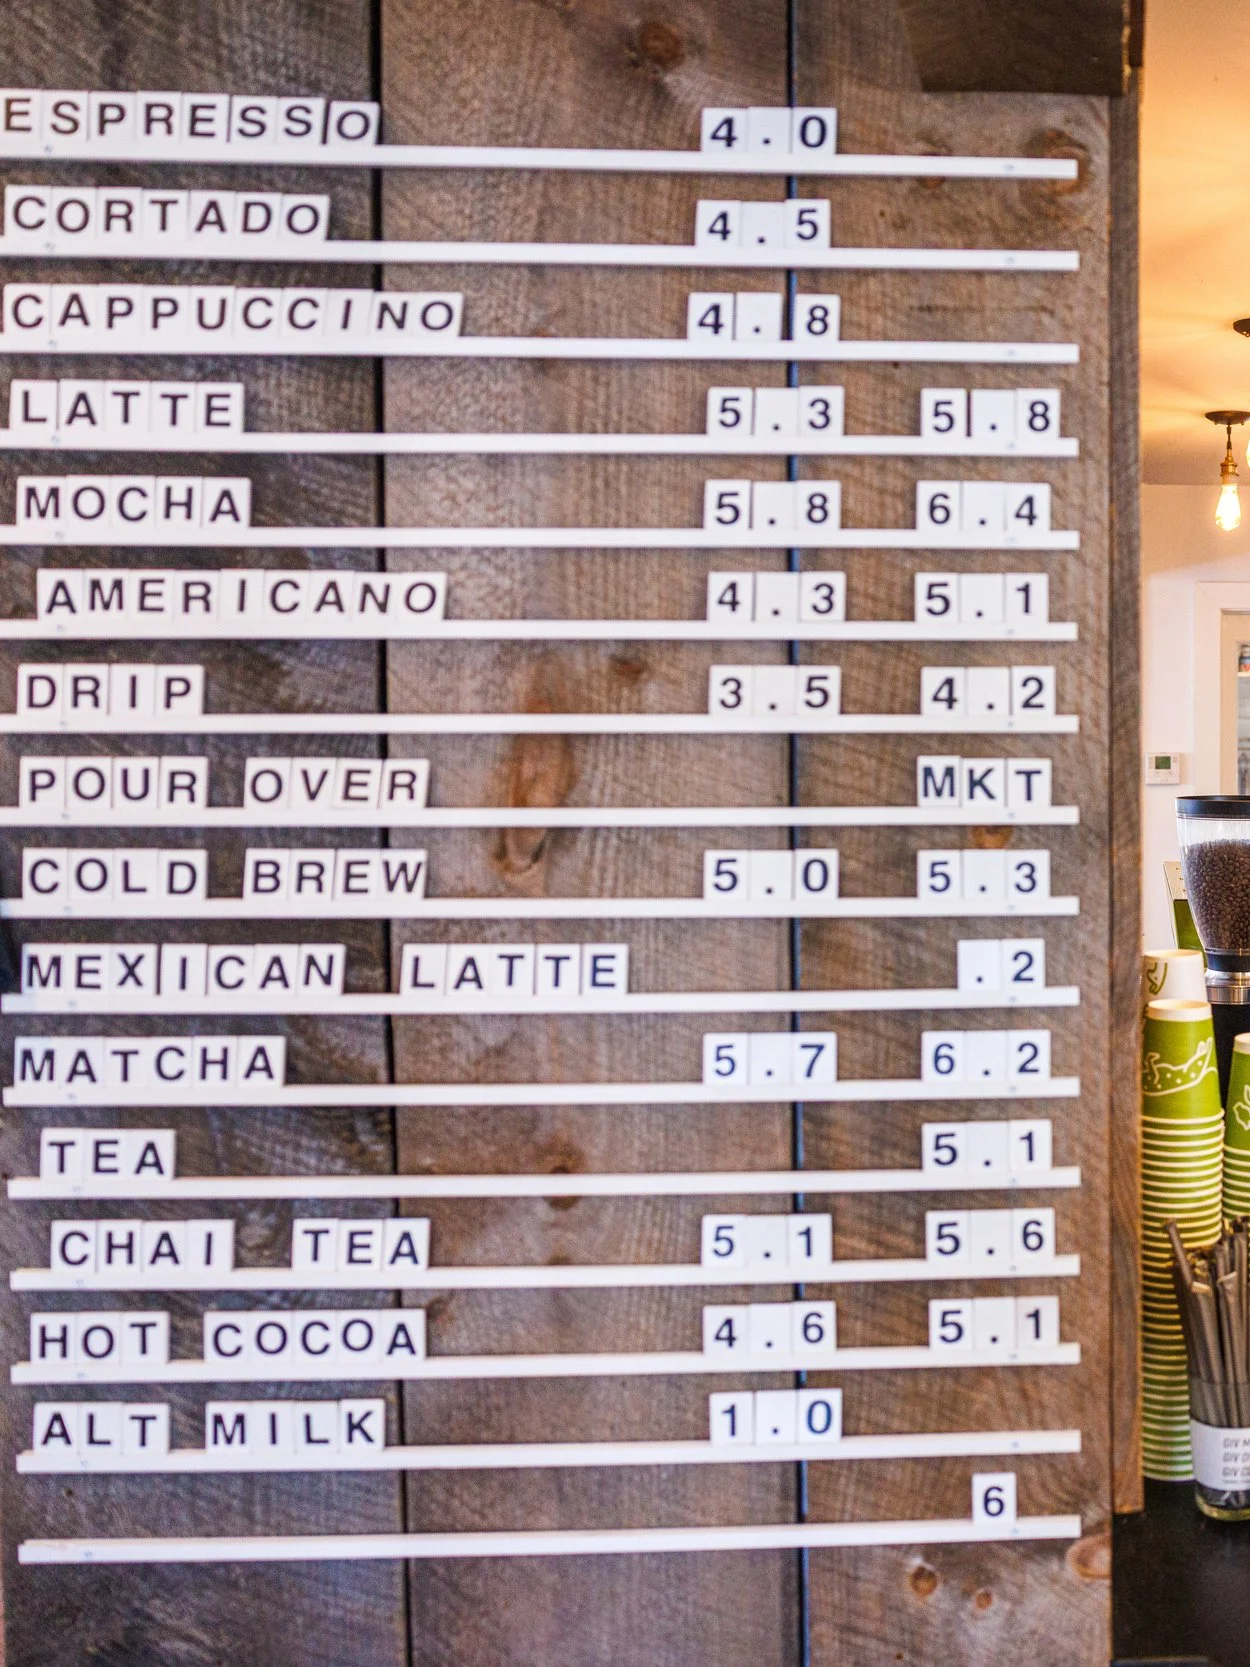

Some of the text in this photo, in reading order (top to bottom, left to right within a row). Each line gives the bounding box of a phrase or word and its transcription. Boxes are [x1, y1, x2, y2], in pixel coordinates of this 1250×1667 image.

[5, 98, 827, 148] ESPRESSO 4.0
[13, 196, 818, 244] CORTADO 4.5
[12, 293, 829, 336] CAPPUCCINO 4.8
[23, 390, 1050, 433] LATTE 5.3 5.8
[25, 486, 1037, 526] MOCHA 5.8 6.4
[46, 579, 1030, 617] AMERICANO 4.3 5.1
[28, 675, 1045, 710] DRIP 3.5 4.2
[30, 766, 1042, 803] POUR OVER MKT
[29, 858, 1036, 895] COLD BREW 5.0 5.3
[27, 951, 1035, 990] MEXICAN LATTE .2
[20, 1042, 1039, 1083] MATCHA 5.7 6.2
[48, 1131, 1034, 1175] TEA 5.1
[60, 1220, 1045, 1266] CHAI TEA 5.1 5.6
[39, 1309, 1040, 1359] HOT COCOA 4.6 5.1
[42, 1400, 832, 1447] ALT MILK 1.0
[983, 1486, 1004, 1517] 6
